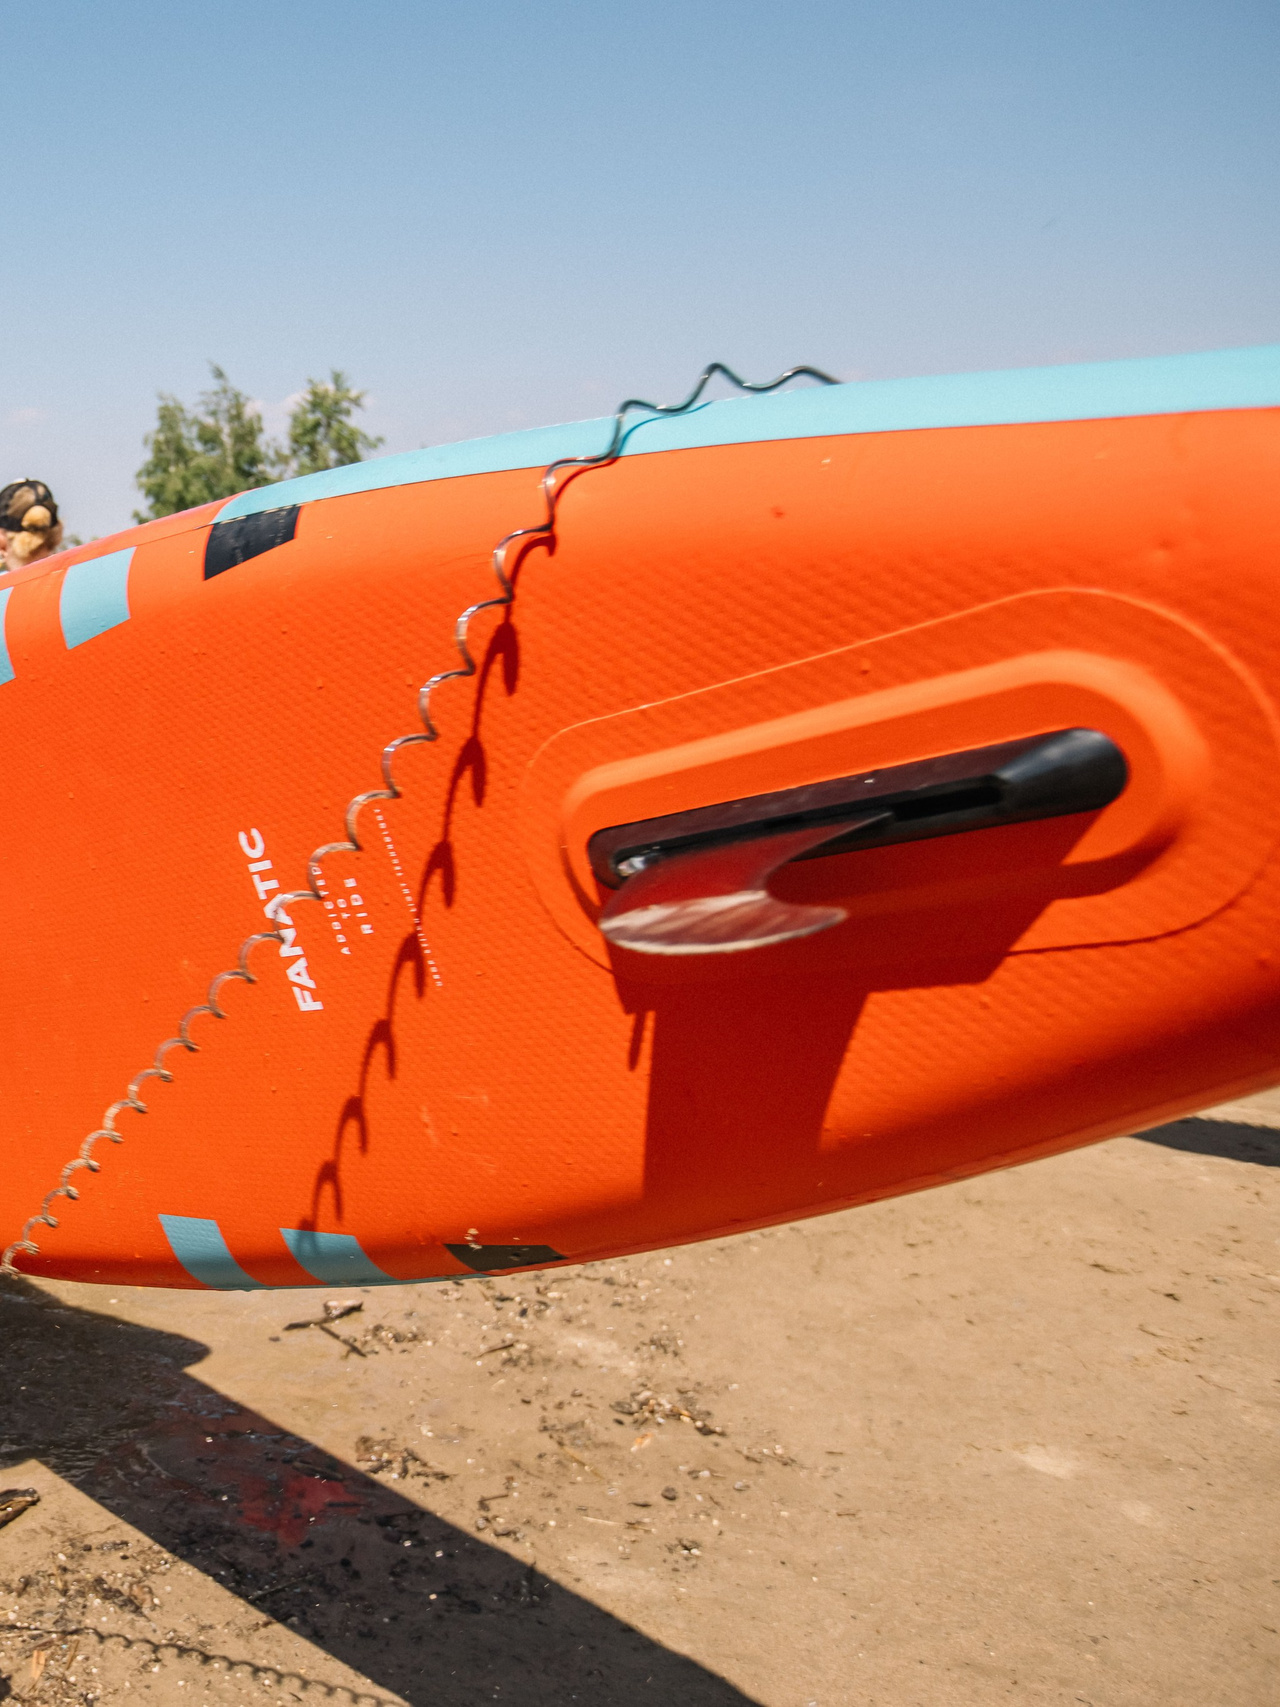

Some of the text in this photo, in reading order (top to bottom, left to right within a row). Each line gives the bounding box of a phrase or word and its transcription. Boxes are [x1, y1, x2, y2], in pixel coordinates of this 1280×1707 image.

[238, 827, 324, 1012] FANATIC
[310, 866, 352, 955] ADDICTED
[336, 898, 351, 919] TO
[343, 878, 374, 935] RIDE
